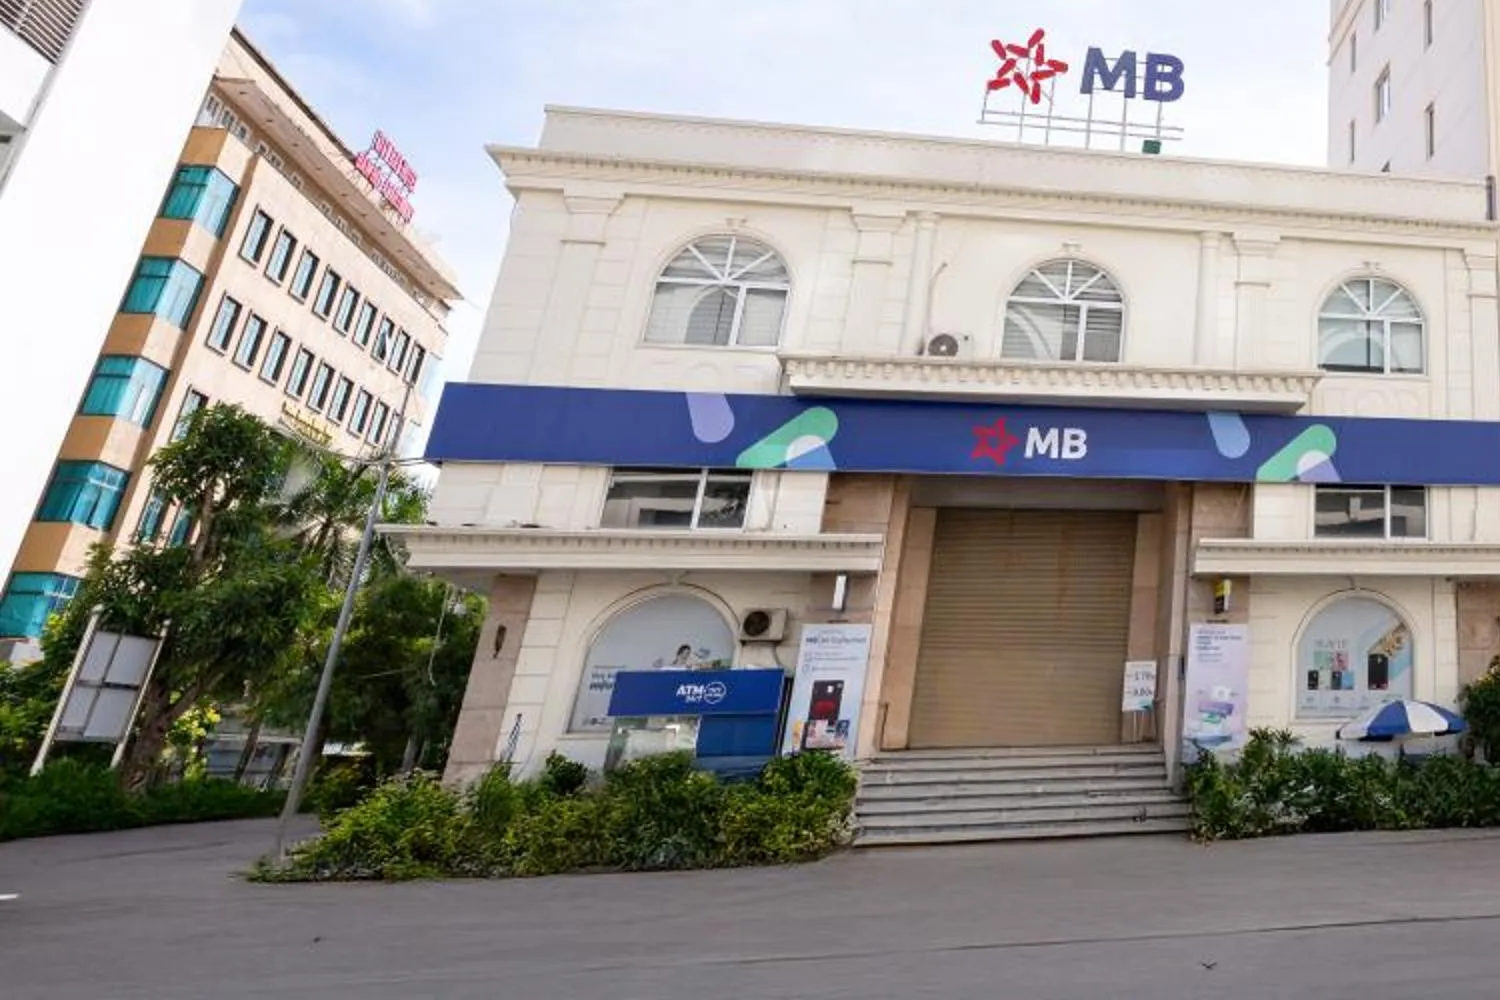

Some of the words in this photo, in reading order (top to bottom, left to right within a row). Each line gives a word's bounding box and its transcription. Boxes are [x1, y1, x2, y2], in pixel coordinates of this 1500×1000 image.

[1079, 46, 1185, 102] MB
[1024, 427, 1088, 459] MB
[675, 684, 704, 698] ATM
